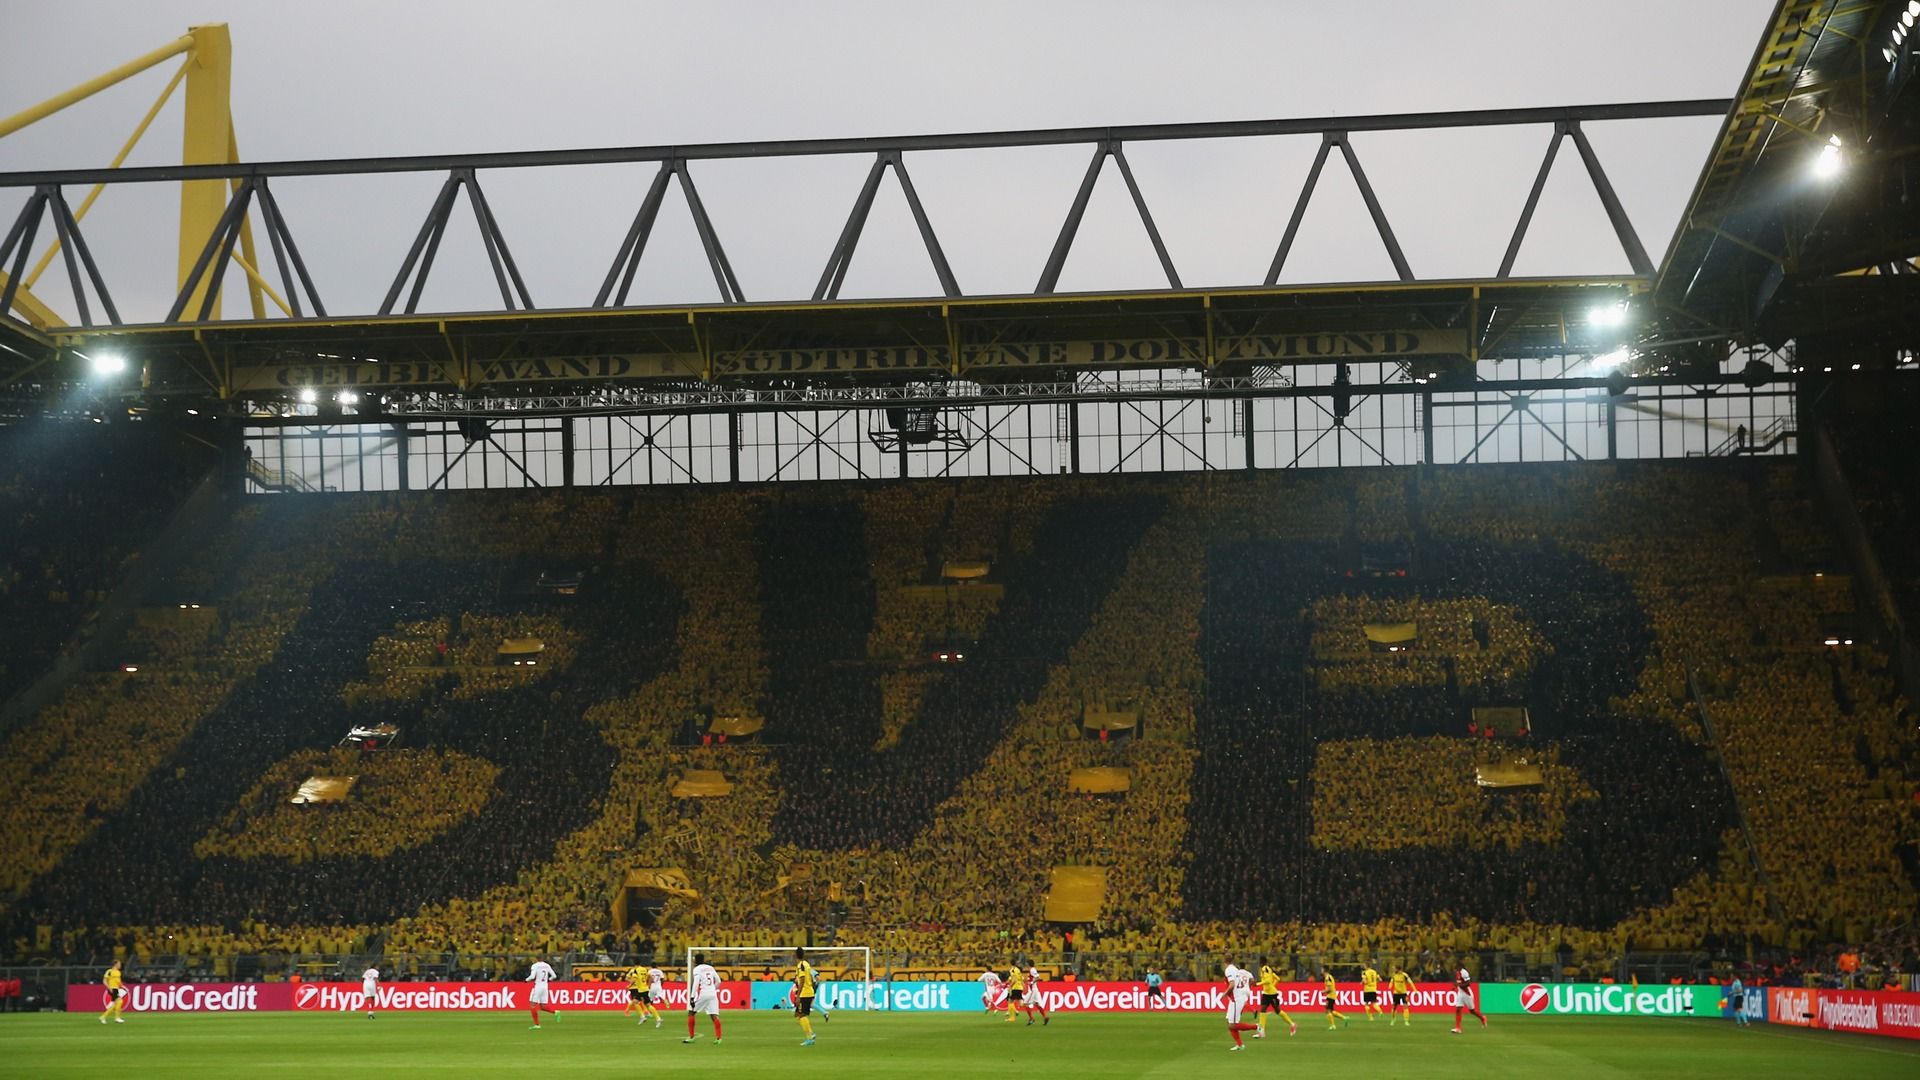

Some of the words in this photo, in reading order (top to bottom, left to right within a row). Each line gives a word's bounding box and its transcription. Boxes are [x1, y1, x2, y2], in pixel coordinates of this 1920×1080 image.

[276, 362, 445, 386] GELBE
[477, 356, 631, 381] WAND
[714, 343, 1068, 373] SÜDTRIBÜNE
[1090, 333, 1420, 361] DORTMUND
[705, 973, 711, 985] 5
[132, 985, 257, 1010] UniCredit
[820, 984, 950, 1009] UniCredit
[1038, 986, 1225, 1012] ypoVereinsbank
[1553, 985, 1694, 1014] UniCredit
